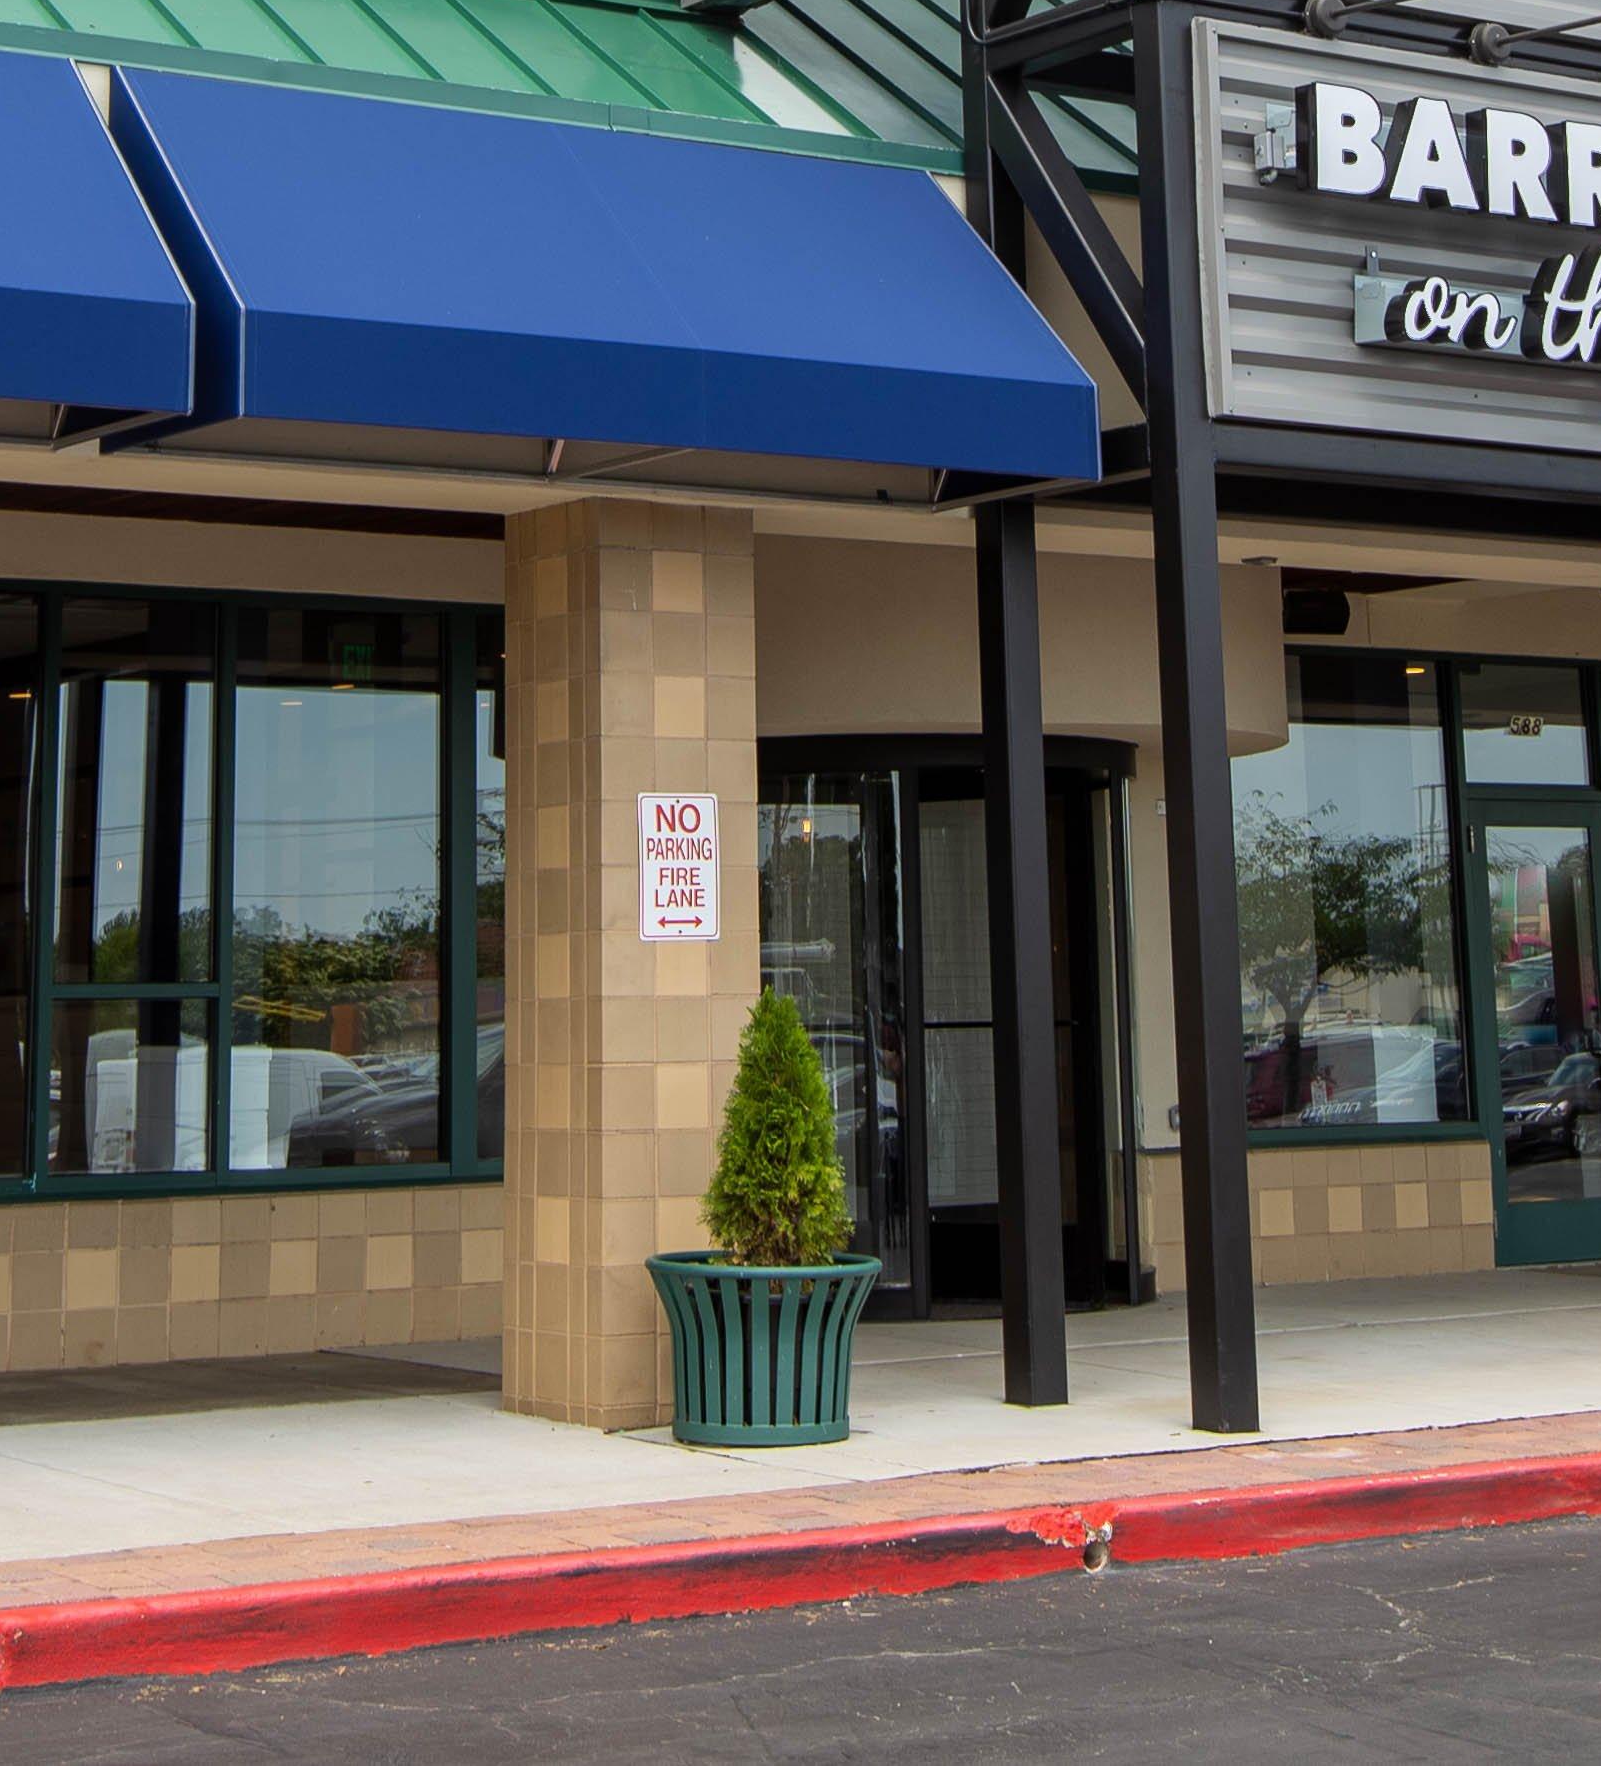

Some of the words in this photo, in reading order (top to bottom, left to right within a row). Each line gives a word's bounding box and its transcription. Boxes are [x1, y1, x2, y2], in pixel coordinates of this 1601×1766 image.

[1402, 275, 1518, 351] on
[655, 803, 702, 833] NO
[646, 837, 713, 861] PARKING
[659, 867, 701, 886] FIRE
[655, 888, 706, 908] LANE
